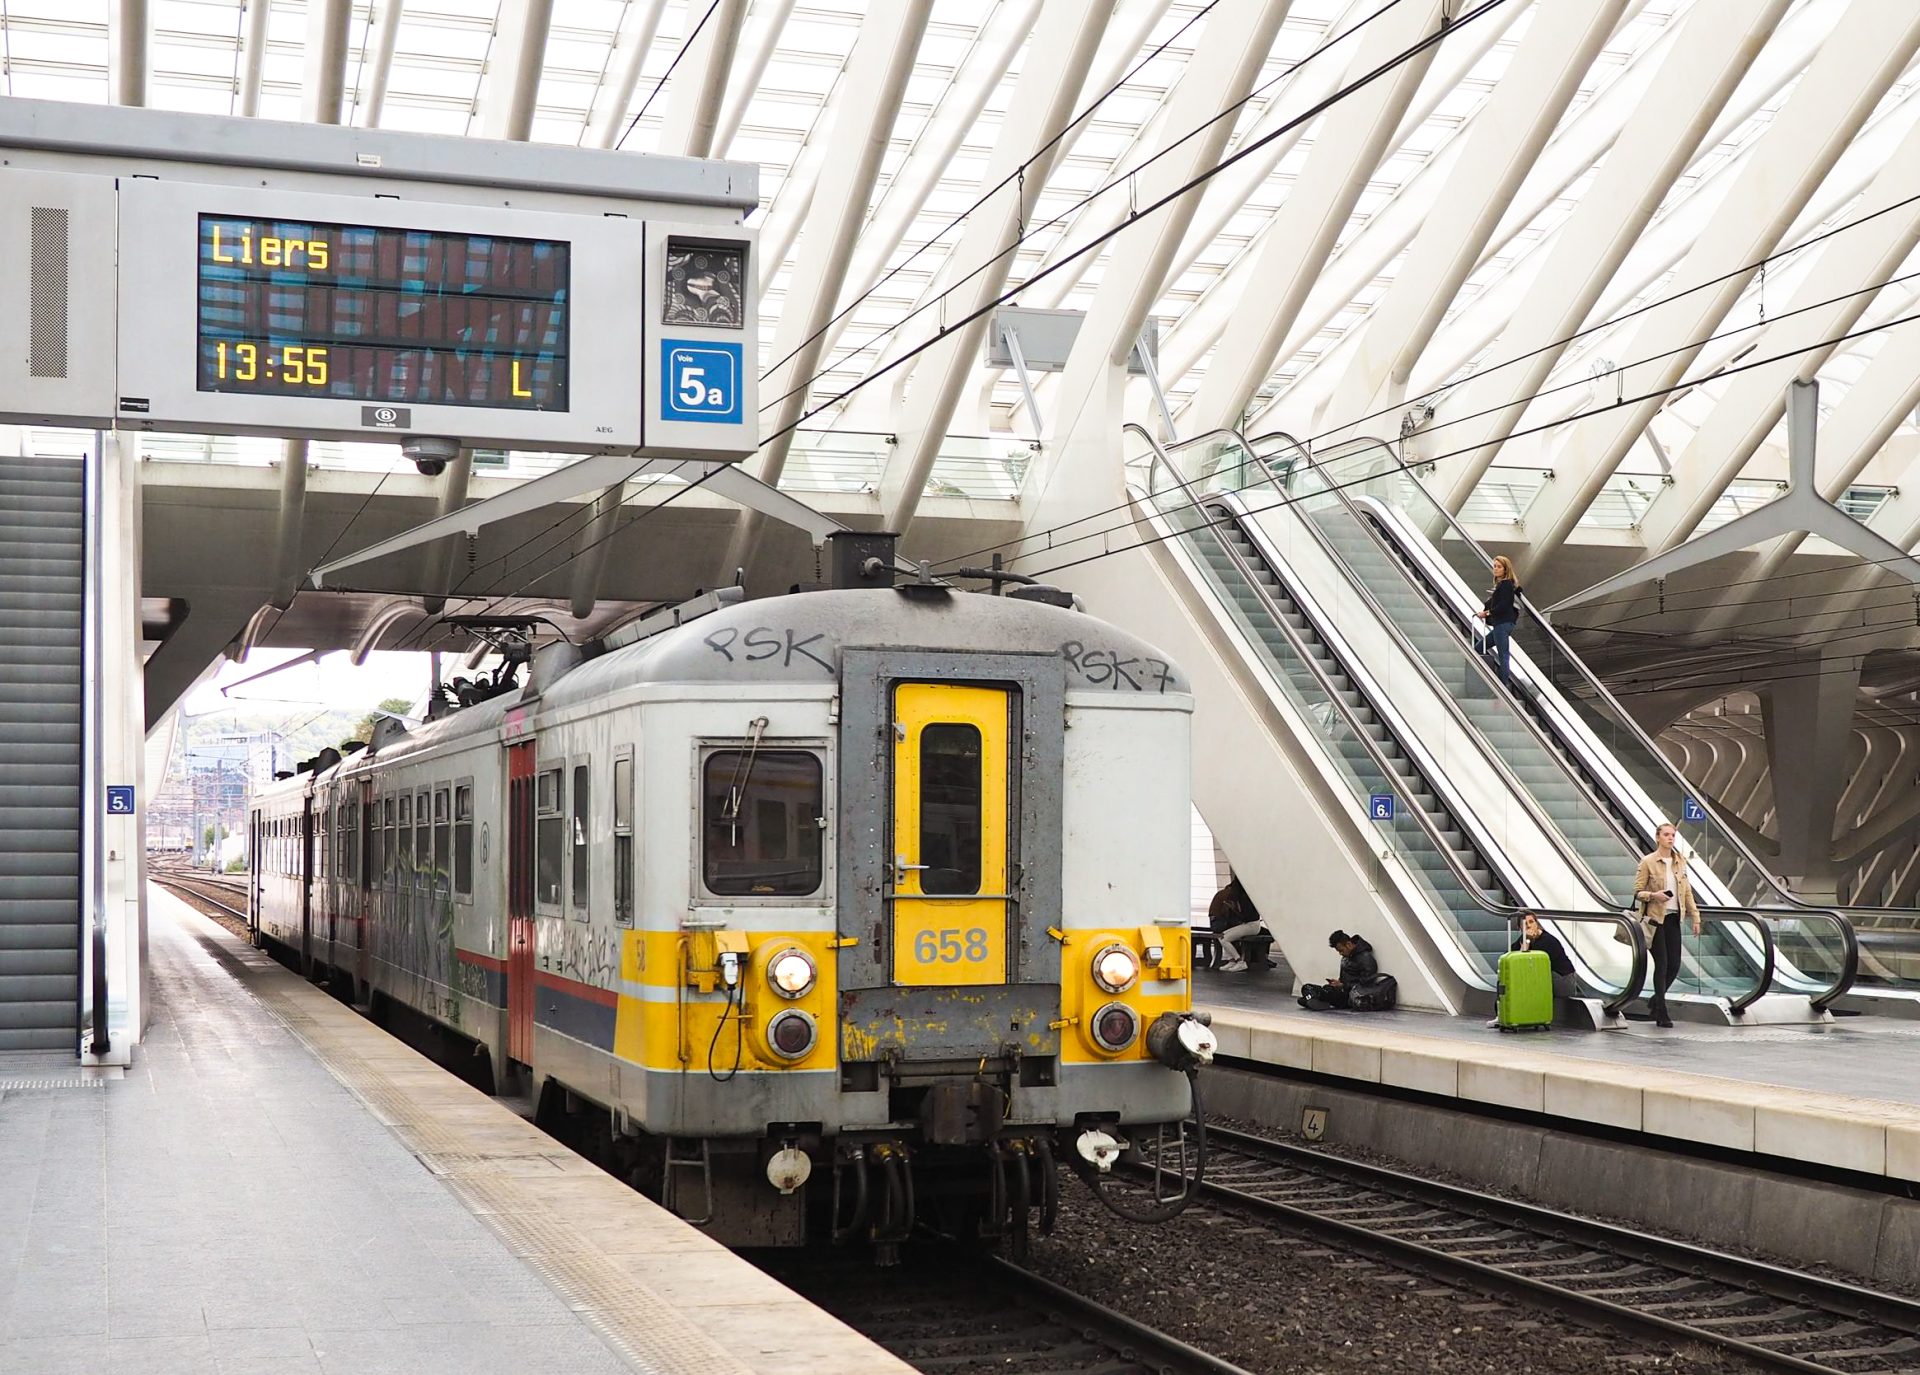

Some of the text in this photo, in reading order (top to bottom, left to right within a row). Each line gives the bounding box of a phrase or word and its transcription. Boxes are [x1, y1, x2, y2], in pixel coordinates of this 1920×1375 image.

[212, 225, 328, 269] Liers
[216, 342, 532, 397] 13:55 L
[677, 354, 694, 363] Voie
[679, 367, 724, 406] 5a
[595, 426, 613, 434] AEG
[914, 927, 988, 964] 658
[1307, 1113, 1319, 1134] 4
